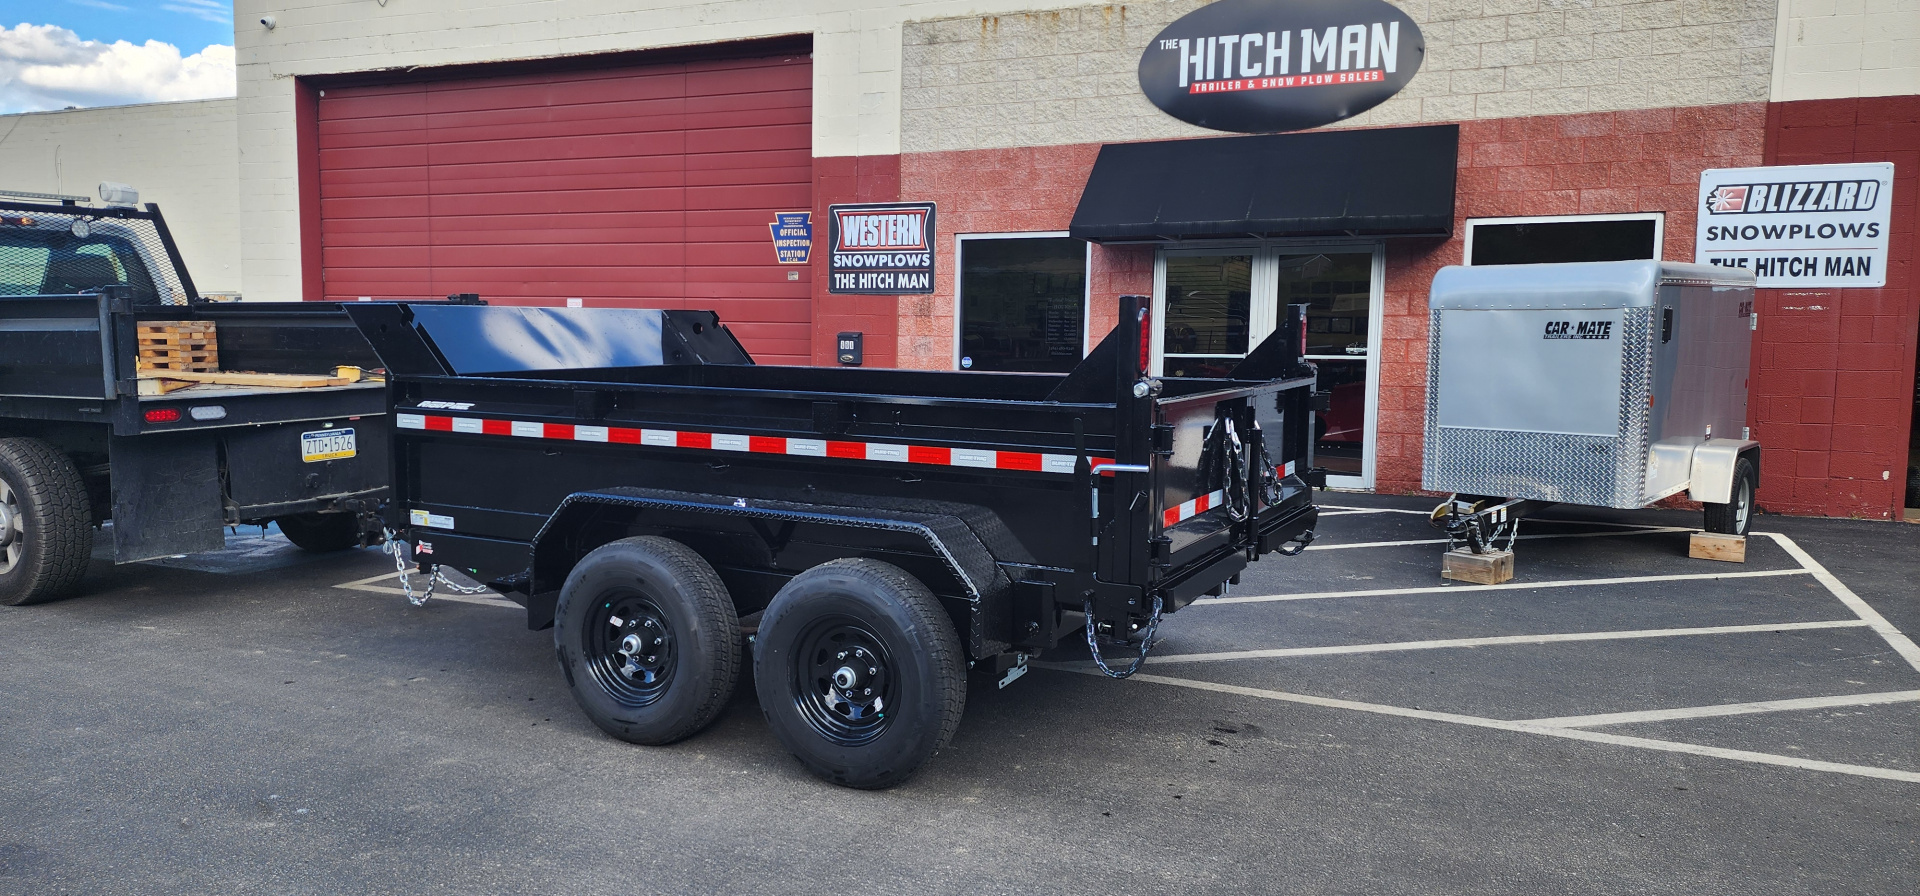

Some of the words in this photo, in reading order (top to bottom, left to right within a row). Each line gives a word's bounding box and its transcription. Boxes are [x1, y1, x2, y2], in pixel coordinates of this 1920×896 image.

[1160, 38, 1179, 50] THE
[1178, 30, 1291, 88] HITCH
[1300, 21, 1400, 74] MAN
[1194, 82, 1241, 93] TRAILER
[1247, 79, 1255, 89] &
[1262, 77, 1295, 88] SNOW
[1301, 74, 1333, 85] PLOW
[1340, 71, 1378, 83] SALES
[1747, 180, 1879, 212] BLIZZARD
[779, 228, 808, 237] OFFICIAL
[842, 213, 922, 248] WESTERN
[1705, 222, 1880, 242] SNOWPLOWS
[776, 239, 811, 247] INSPECTION
[780, 250, 806, 258] STATION
[833, 254, 931, 268] SNOWPLOWS
[1755, 256, 1818, 278] HITCH
[1824, 255, 1872, 277] MAN
[834, 273, 856, 289] THE
[859, 273, 894, 289] HITCH
[897, 272, 930, 289] MAN
[1545, 321, 1570, 335] CAR
[1576, 321, 1613, 335] MATE
